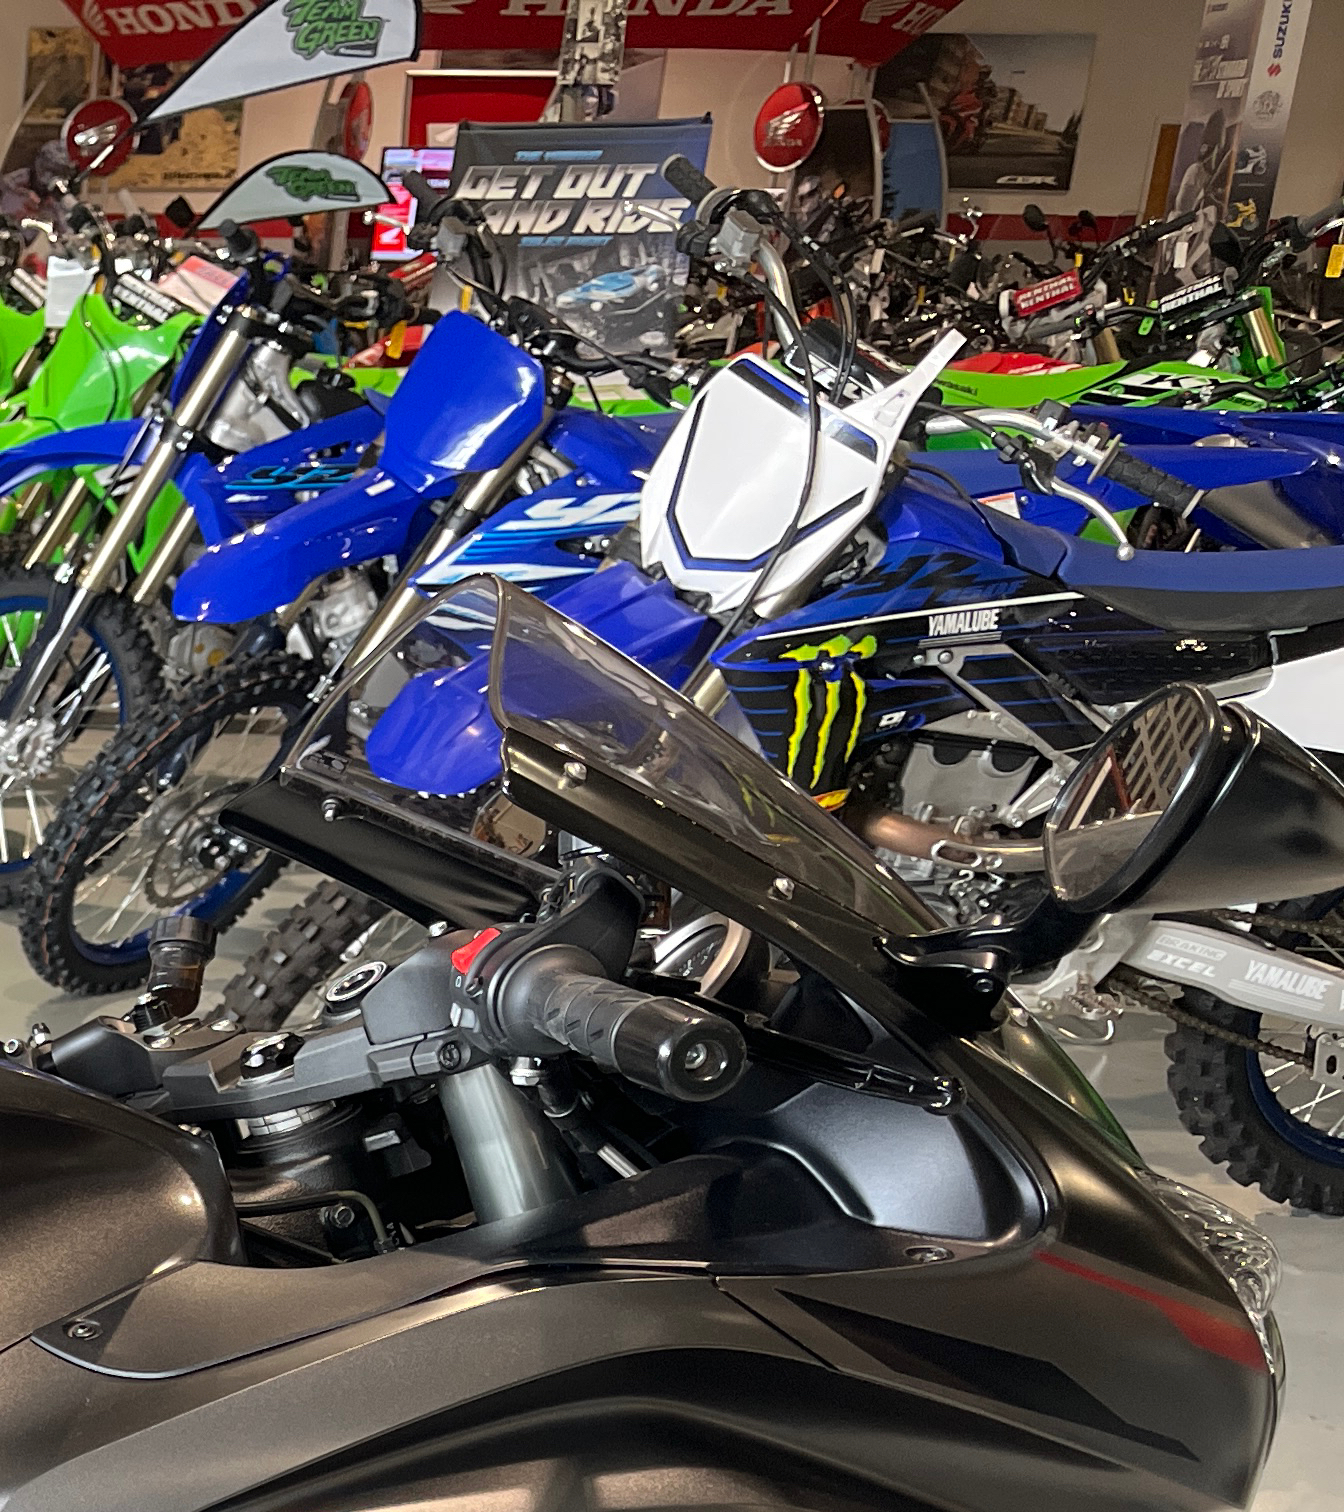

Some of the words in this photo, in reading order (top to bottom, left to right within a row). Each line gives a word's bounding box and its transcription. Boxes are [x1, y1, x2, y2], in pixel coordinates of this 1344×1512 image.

[103, 0, 258, 35] HOND
[283, 0, 360, 27] TEAM
[1272, 0, 1292, 59] SUZUK
[295, 20, 380, 56] GREEN
[453, 164, 556, 200] GET
[552, 162, 660, 200] OUT
[479, 200, 571, 235] AND
[928, 608, 1002, 637] YAMALUBE
[1146, 949, 1217, 978] EXCEL
[1243, 959, 1336, 1001] YAMALUBE
